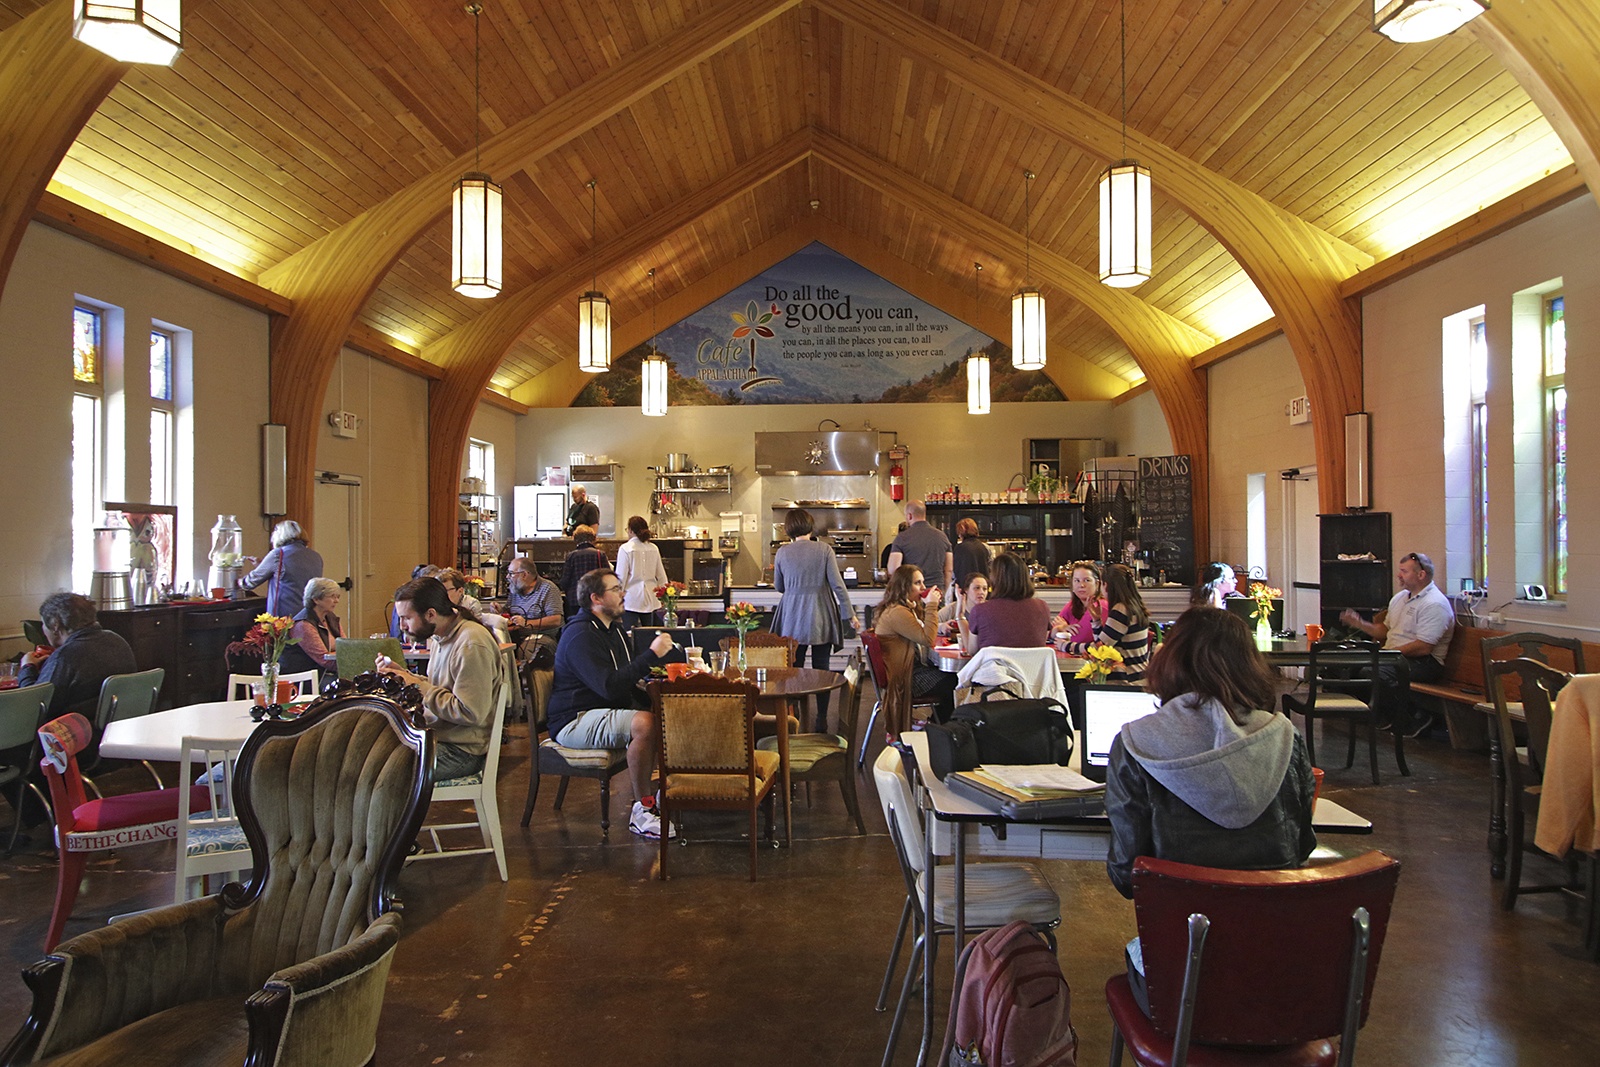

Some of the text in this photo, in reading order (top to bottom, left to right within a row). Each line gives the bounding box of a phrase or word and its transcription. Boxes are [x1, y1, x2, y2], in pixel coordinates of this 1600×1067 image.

[765, 285, 840, 301] Do all the
[784, 295, 919, 328] good you can,
[801, 325, 811, 336] by
[813, 325, 823, 333] all
[825, 324, 836, 333] the
[863, 325, 877, 335] you
[878, 325, 894, 333] can,
[895, 323, 903, 332] in
[905, 323, 915, 332] all
[916, 323, 928, 331] the
[929, 324, 949, 333] ways
[782, 335, 931, 348] you can, in all the places you can, to all
[783, 350, 795, 359] the
[797, 349, 821, 361] people
[823, 351, 838, 360] you
[867, 348, 884, 359] long
[896, 350, 910, 359] you
[930, 349, 947, 357] can.
[697, 368, 747, 381] APPALACHIA
[1292, 398, 1304, 417] EXIT
[1140, 455, 1189, 478] DRINKS
